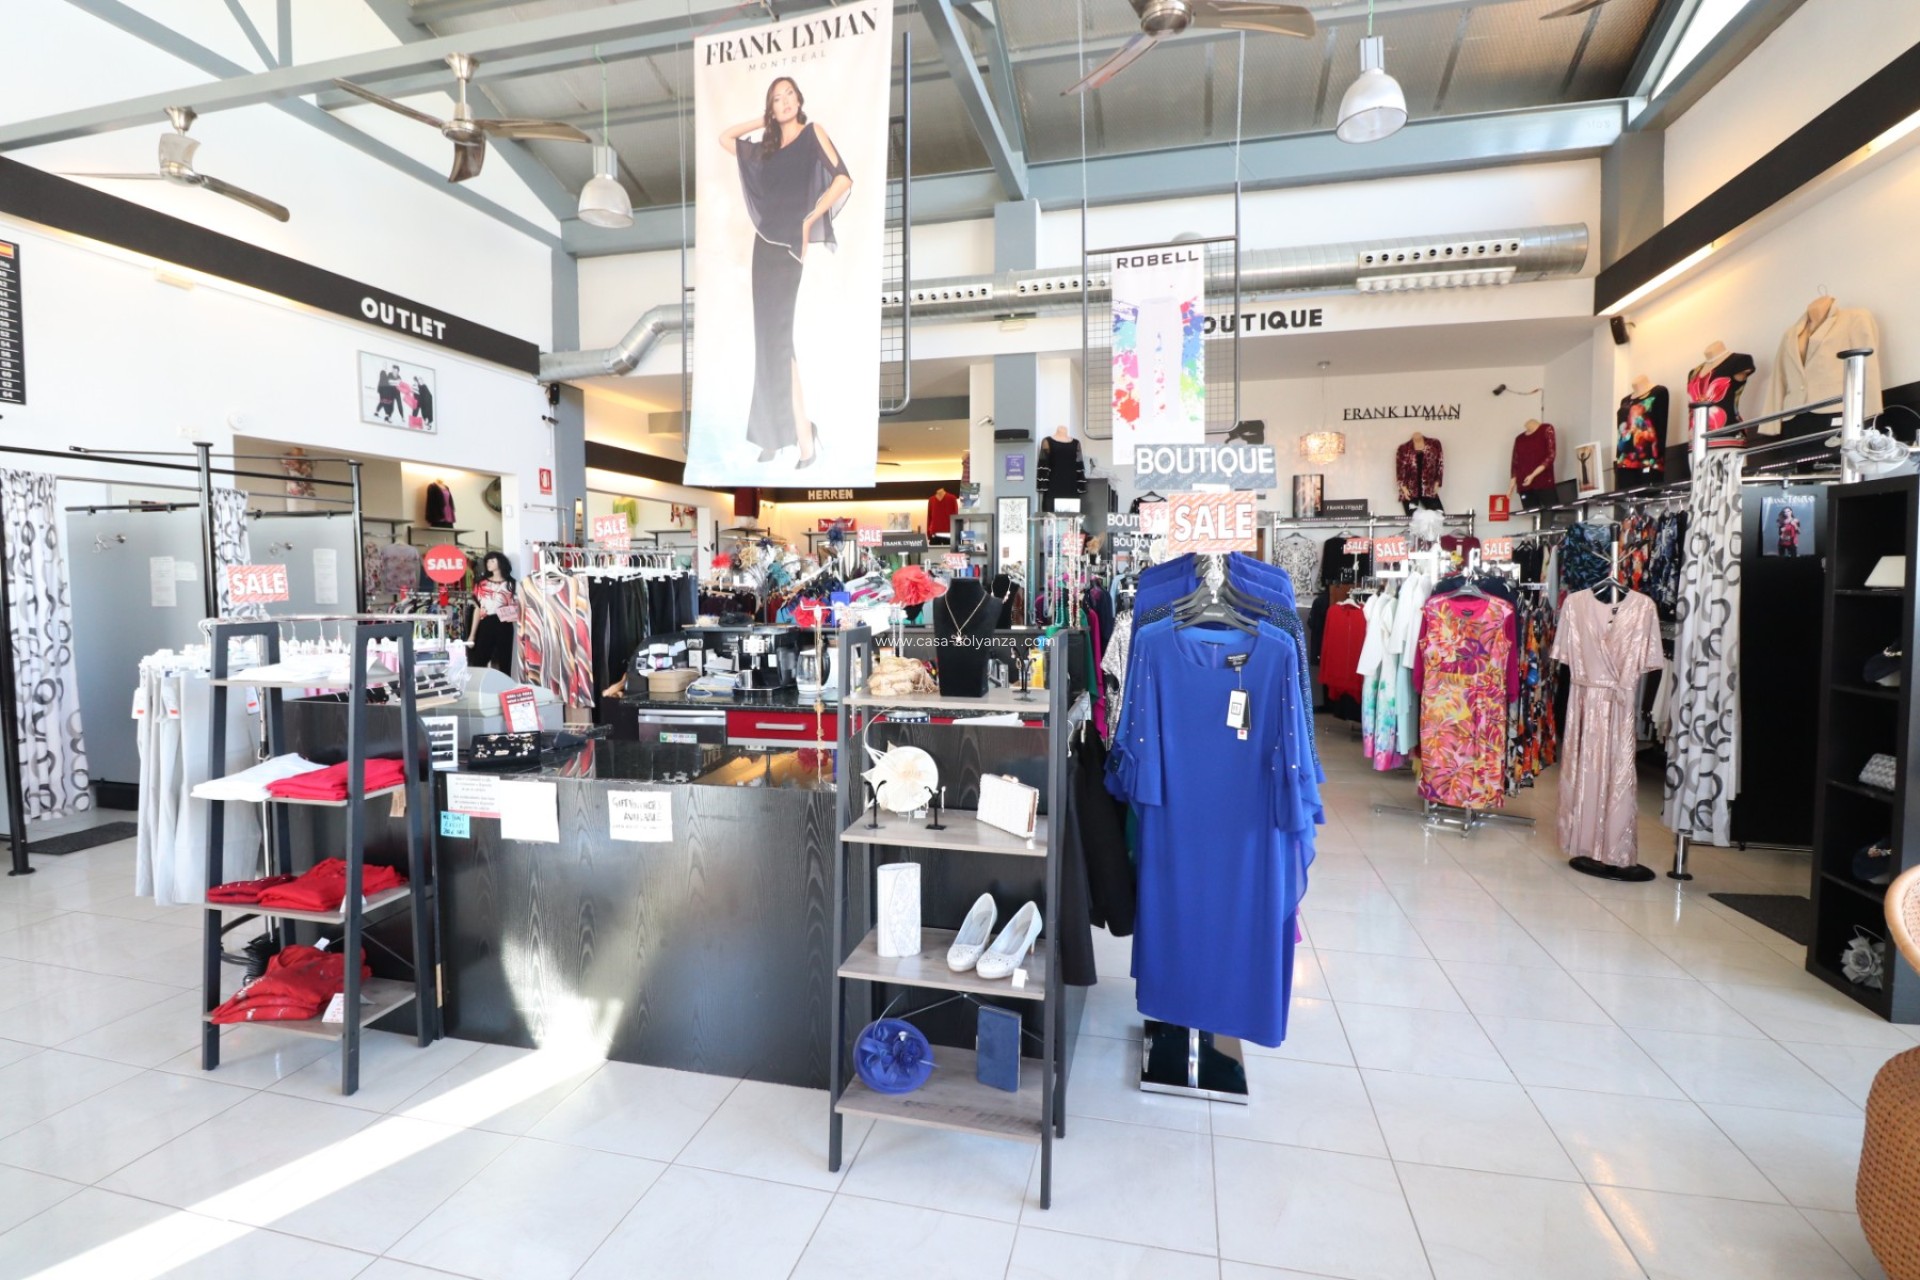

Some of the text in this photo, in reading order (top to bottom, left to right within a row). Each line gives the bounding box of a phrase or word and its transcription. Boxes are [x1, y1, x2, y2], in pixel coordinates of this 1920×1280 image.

[706, 7, 878, 66] FRANK LYMAN
[749, 51, 827, 72] MONTREAL
[1116, 250, 1199, 270] ROBELL
[360, 296, 446, 340] OUTLET
[1204, 309, 1323, 335] OUTIQUE
[1343, 403, 1461, 421] FRANK LYMAN
[1136, 446, 1275, 477] BOUTIQUE
[808, 489, 854, 500] HERREN
[595, 517, 627, 537] SALE
[1174, 503, 1252, 542] SALE
[858, 528, 881, 542] SALE
[1346, 540, 1369, 552] SALE
[1377, 541, 1406, 558] SALE
[1484, 541, 1511, 556] SALE
[426, 558, 464, 570] SALE
[232, 573, 286, 596] SALE
